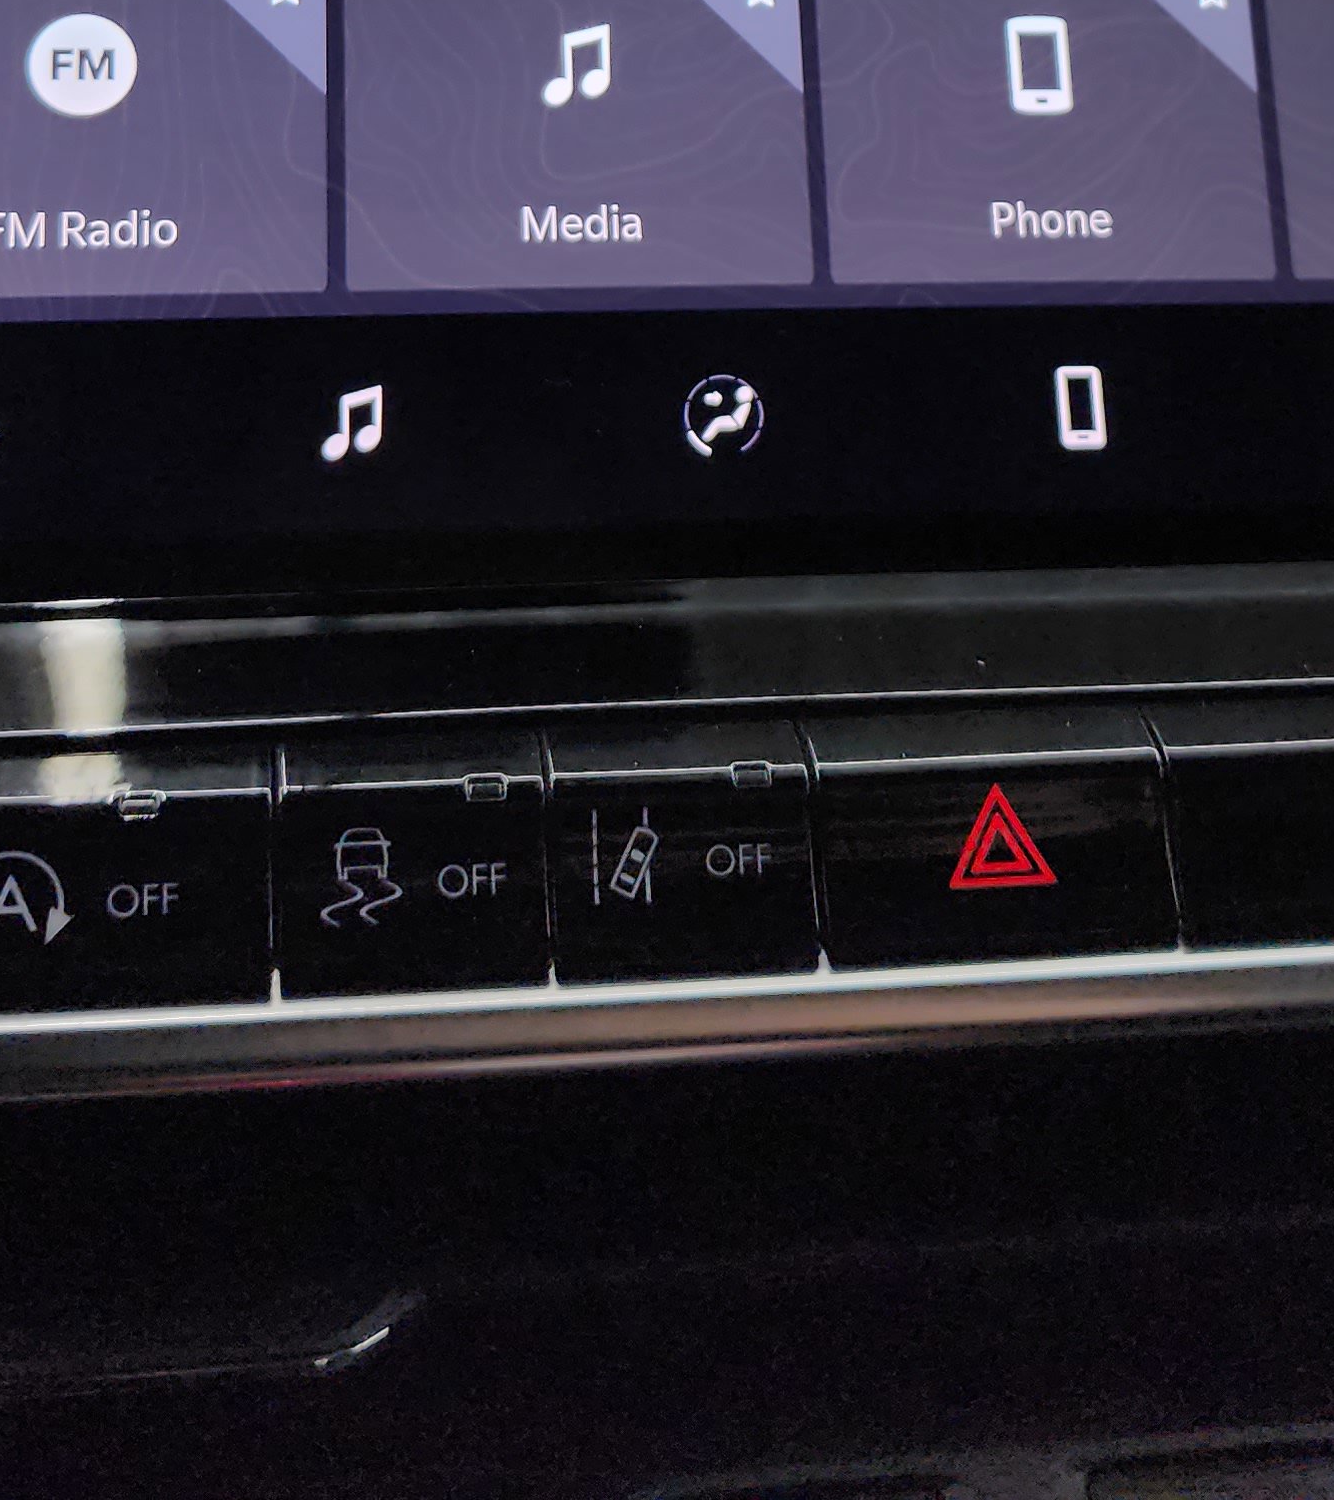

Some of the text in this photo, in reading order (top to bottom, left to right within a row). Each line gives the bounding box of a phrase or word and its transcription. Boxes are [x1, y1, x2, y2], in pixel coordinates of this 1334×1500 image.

[51, 49, 114, 80] FM
[58, 209, 178, 249] Radio
[520, 203, 643, 243] Media
[990, 201, 1113, 242] Phone
[704, 842, 772, 877] OFF
[437, 863, 507, 898] OFF
[107, 882, 179, 918] OFF
